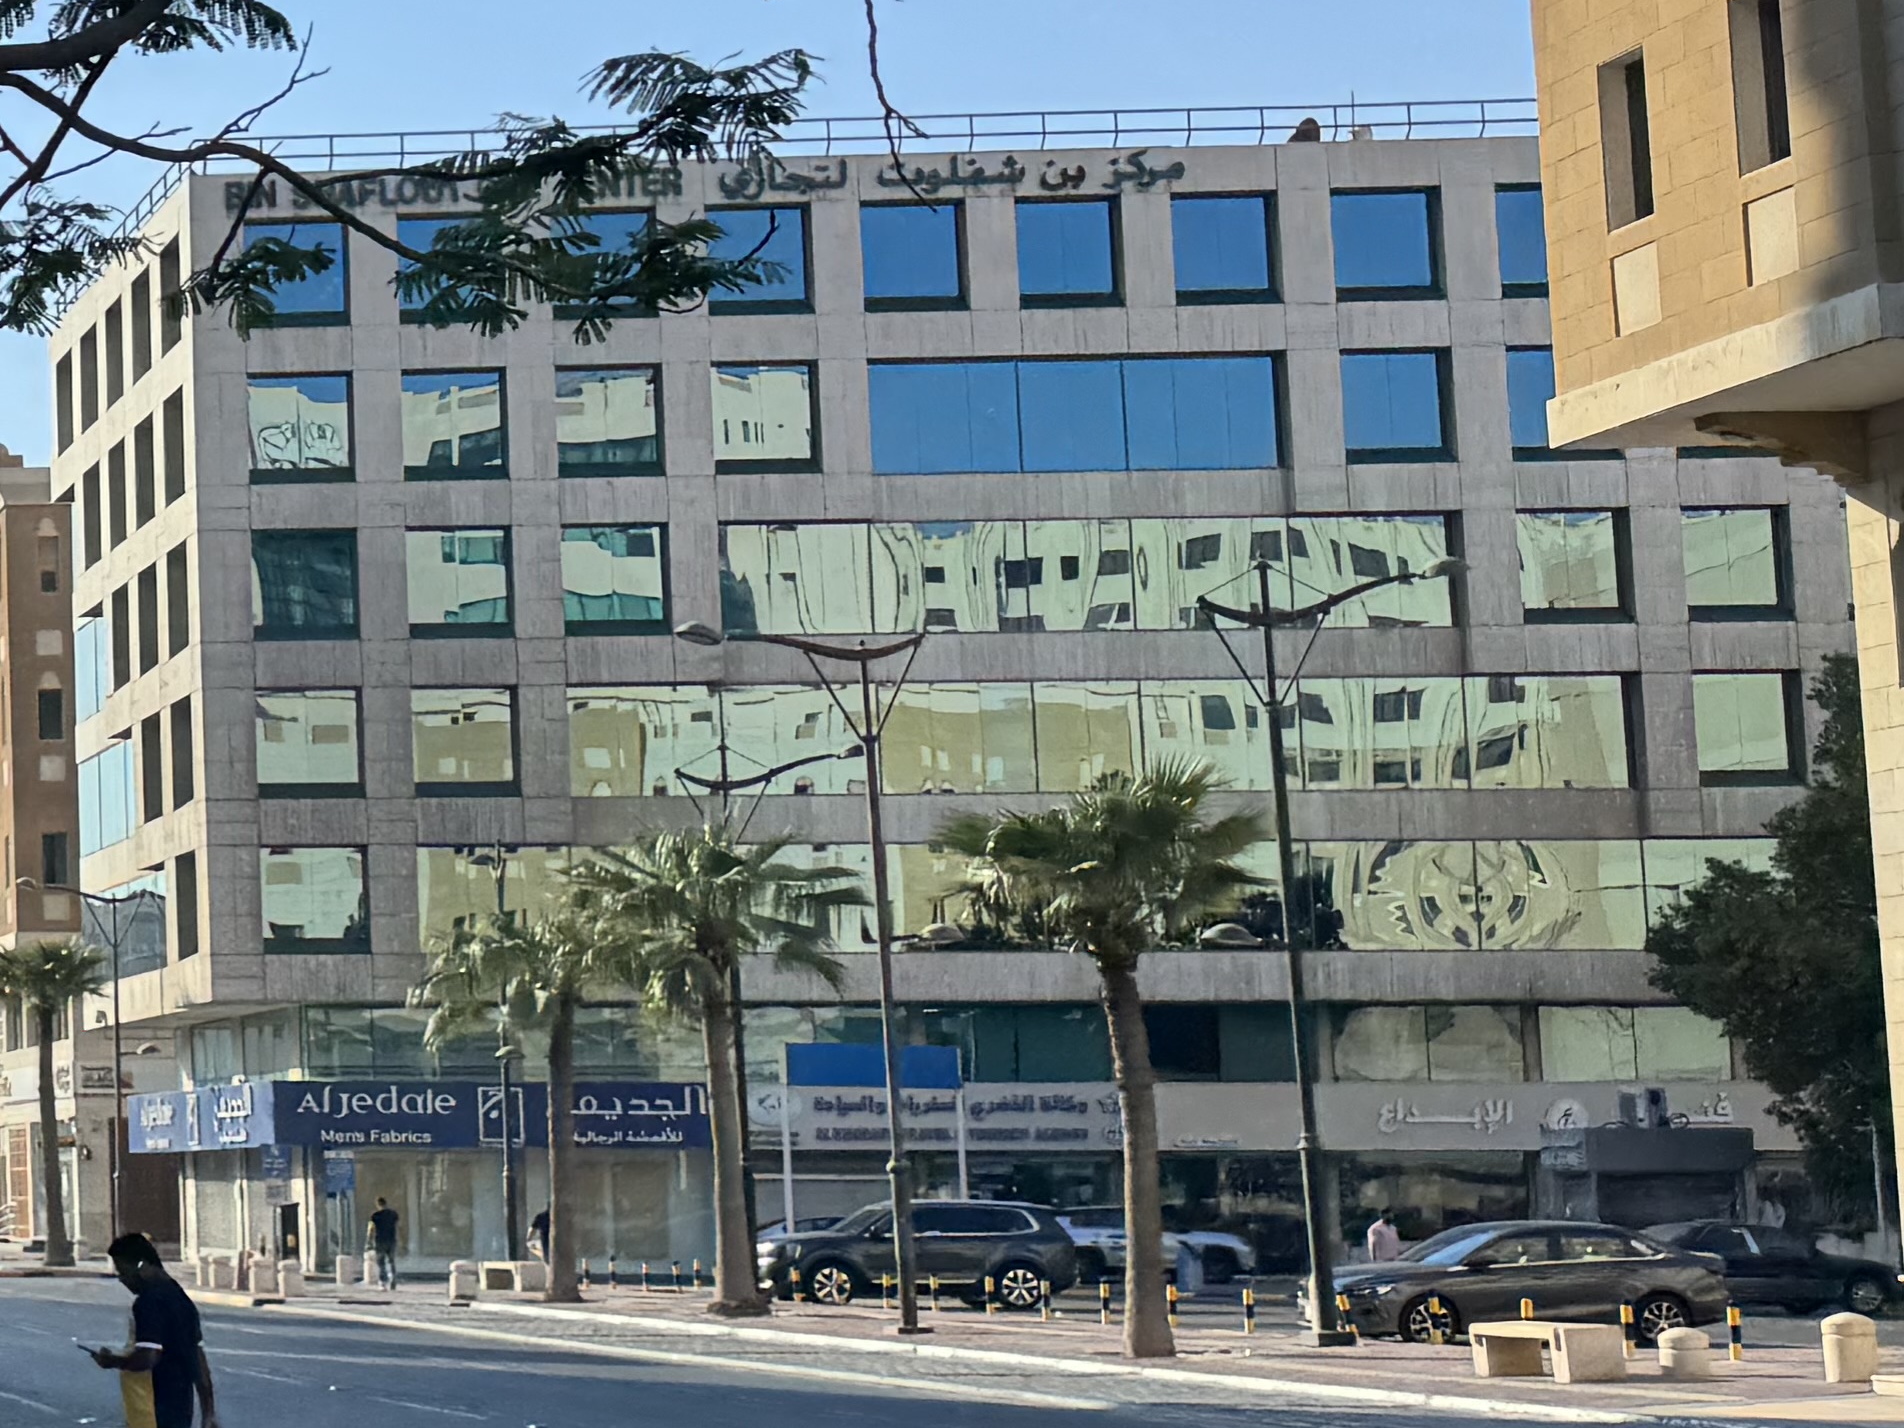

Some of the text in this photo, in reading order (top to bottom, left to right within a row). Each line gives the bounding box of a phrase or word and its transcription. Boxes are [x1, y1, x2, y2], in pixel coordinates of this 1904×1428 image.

[1038, 158, 1086, 192] بن
[224, 178, 277, 209] BIN
[369, 1128, 433, 1145] Fabrics
